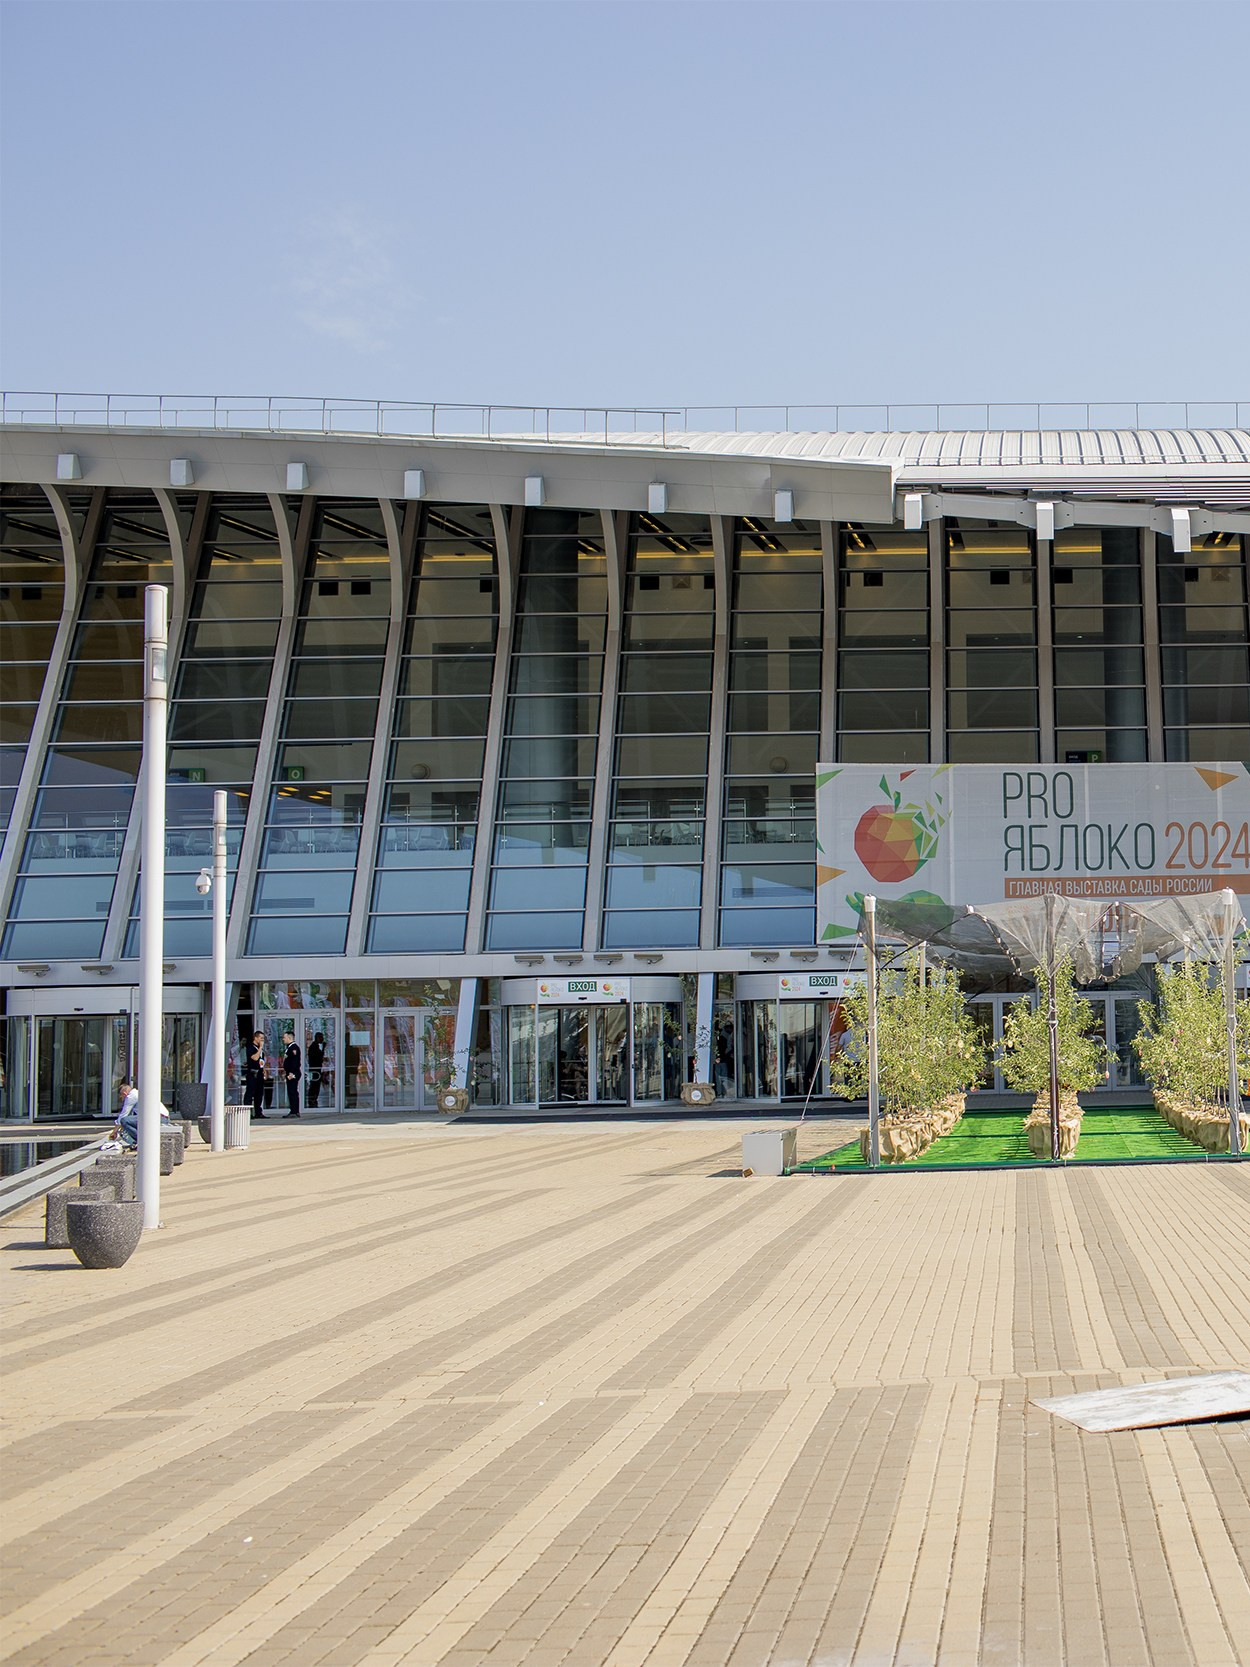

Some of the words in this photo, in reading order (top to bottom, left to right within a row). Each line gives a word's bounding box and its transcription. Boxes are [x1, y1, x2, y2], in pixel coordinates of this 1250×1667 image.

[192, 771, 201, 781] N
[1003, 771, 1074, 819] PRO
[1003, 823, 1156, 871] ЯБЛОКО
[1009, 880, 1062, 896] ГЛАВНАЯ
[1066, 880, 1127, 895] ВЫСТАВКА
[1130, 879, 1163, 895] САДЫ
[1166, 878, 1213, 894] РОССИИ
[570, 982, 596, 991] ВХОД
[811, 976, 836, 985] ВХОД
